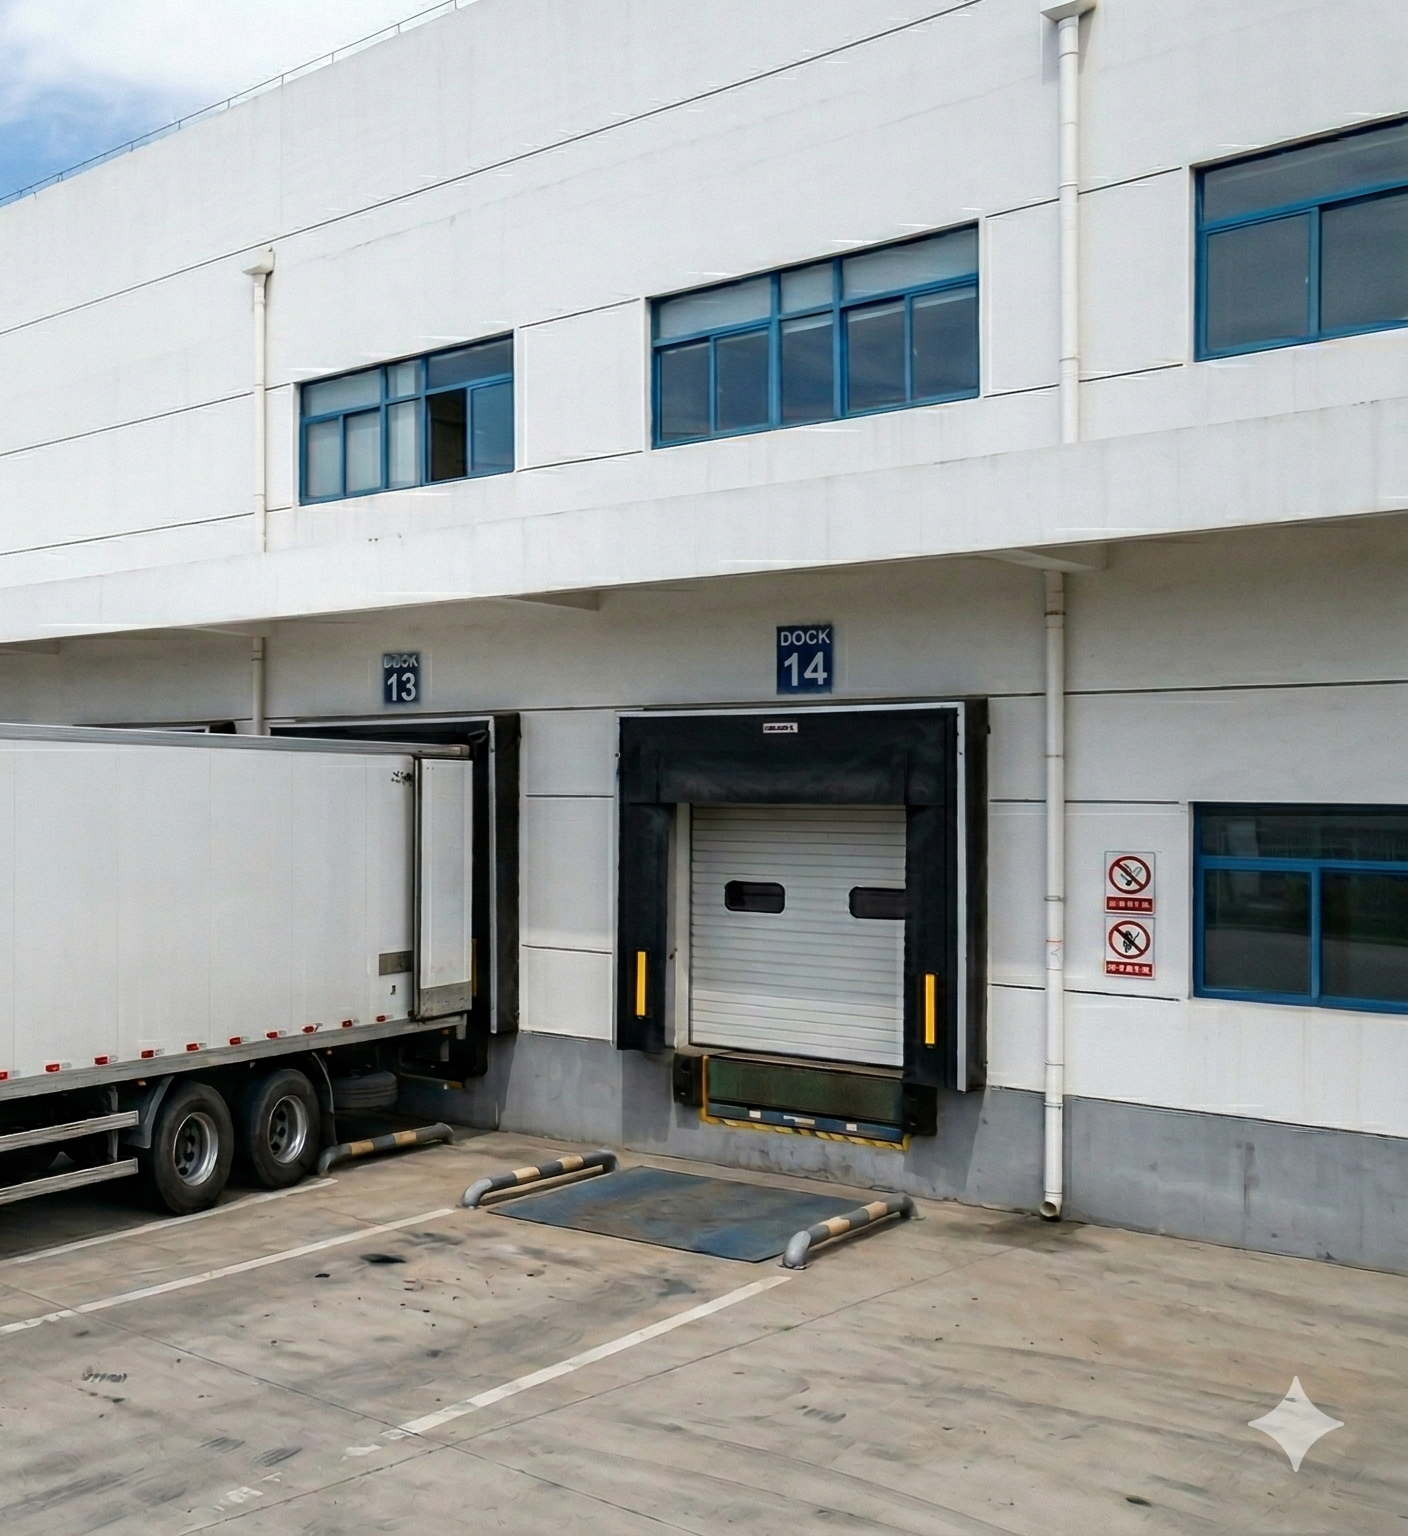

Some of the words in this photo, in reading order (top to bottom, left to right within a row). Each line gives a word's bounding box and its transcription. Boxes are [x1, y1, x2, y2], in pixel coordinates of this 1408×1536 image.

[780, 628, 831, 646] DOCK
[784, 651, 828, 687] 14
[387, 672, 417, 701] 13
